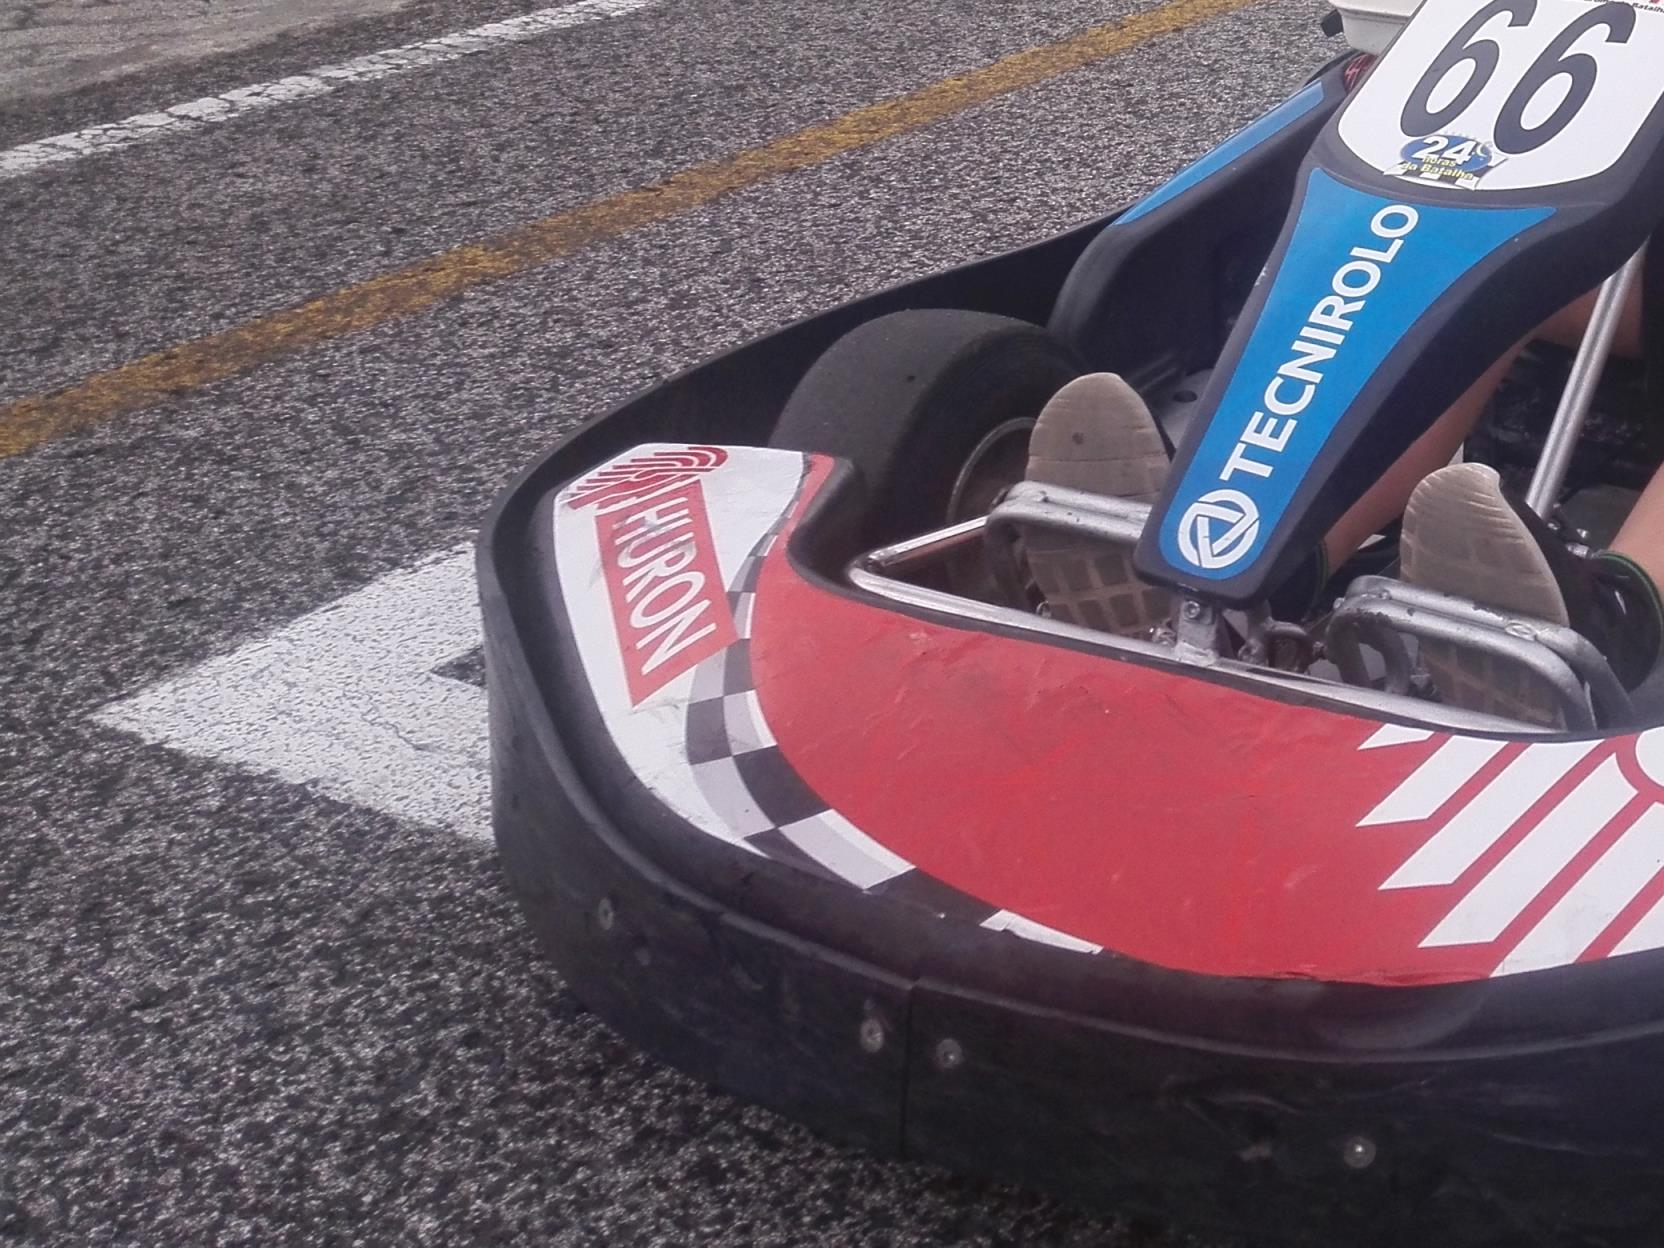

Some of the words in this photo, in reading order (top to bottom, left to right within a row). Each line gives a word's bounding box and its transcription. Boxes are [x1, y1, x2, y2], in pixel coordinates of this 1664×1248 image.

[1411, 136, 1478, 165] 24
[1421, 163, 1474, 181] Batalha
[1220, 204, 1420, 482] TECNIROLO
[612, 497, 717, 676] HURON
